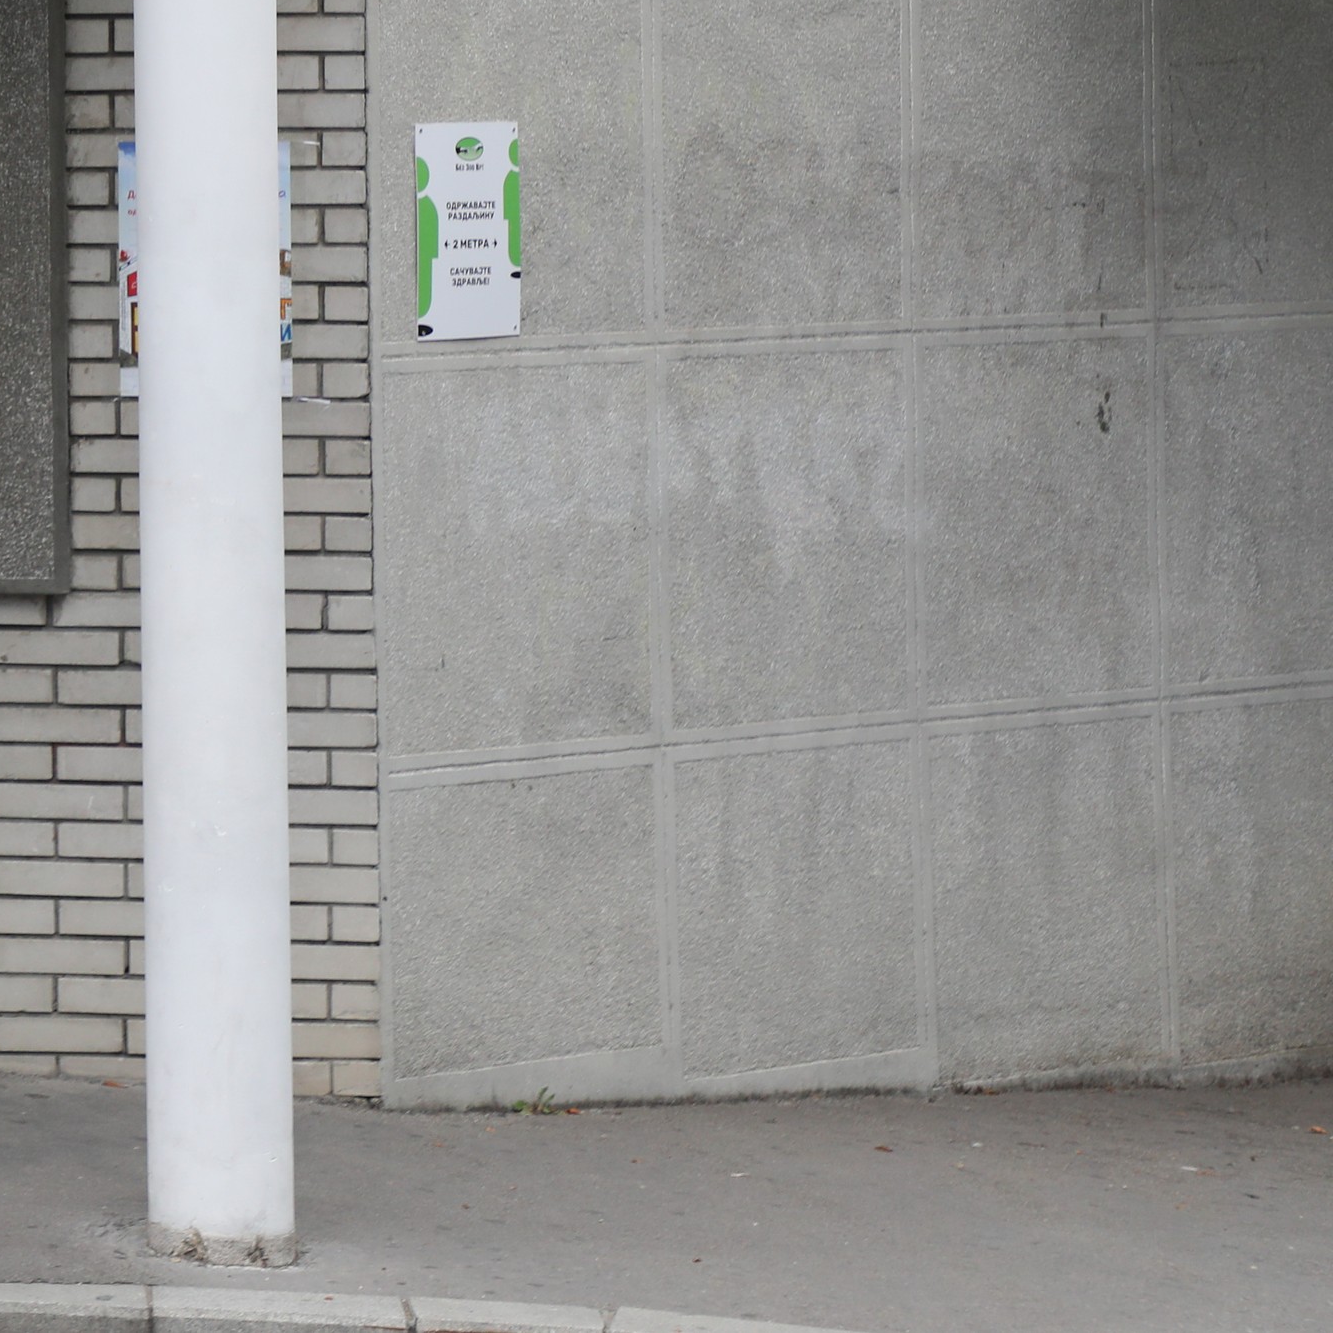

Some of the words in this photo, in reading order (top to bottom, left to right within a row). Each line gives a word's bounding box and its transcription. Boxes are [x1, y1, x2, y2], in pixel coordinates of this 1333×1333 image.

[446, 201, 496, 211] ОДРЖАВАЈТЕ
[447, 211, 495, 221] РАЗДАЉИНУ
[452, 239, 459, 249] 2
[460, 239, 489, 250] МЕТРА
[450, 266, 492, 276] САЧУВАЈТЕ
[451, 276, 490, 287] ЗДРАВЉЕ!
